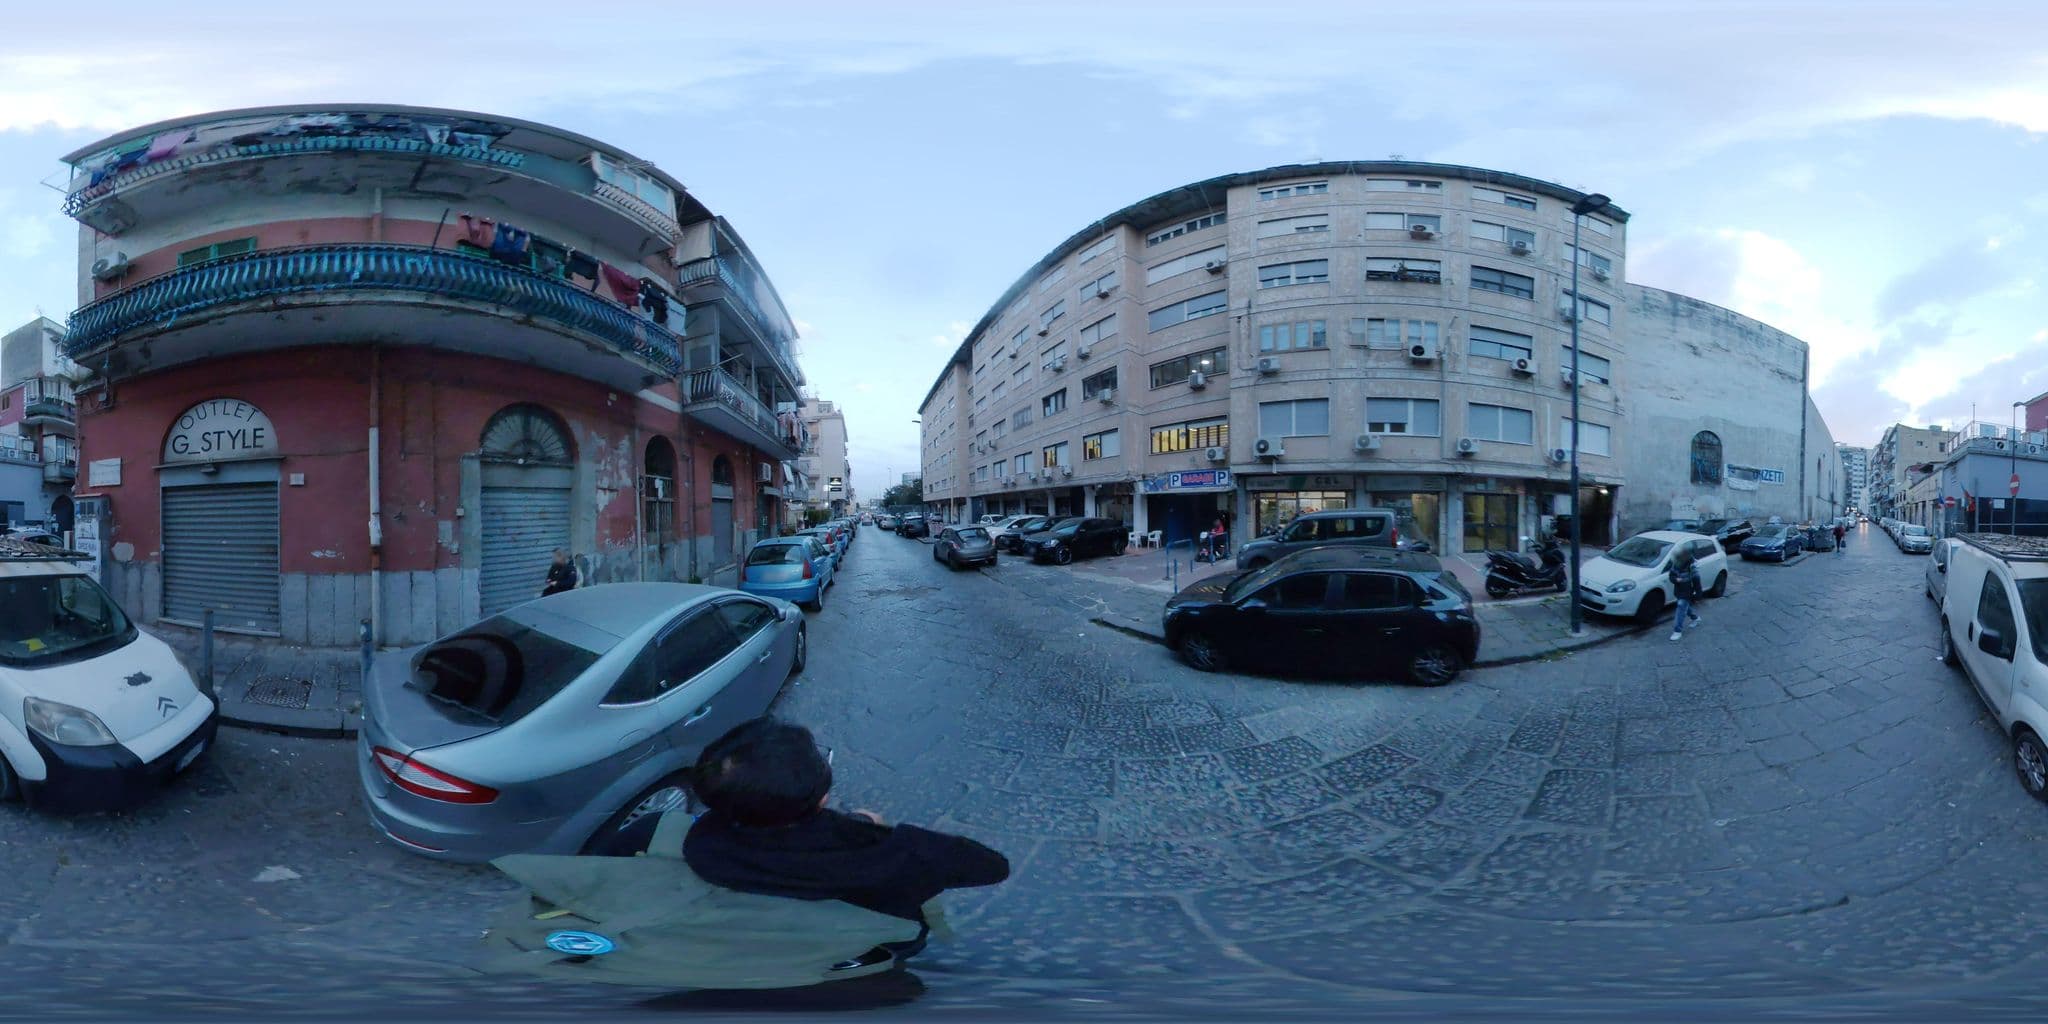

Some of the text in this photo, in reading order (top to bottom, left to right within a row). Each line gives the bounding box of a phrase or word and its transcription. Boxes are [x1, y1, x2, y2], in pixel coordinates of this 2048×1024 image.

[180, 400, 259, 430] OUTLET
[172, 428, 265, 455] G_STYLE
[1172, 471, 1226, 486] P GARAGE P
